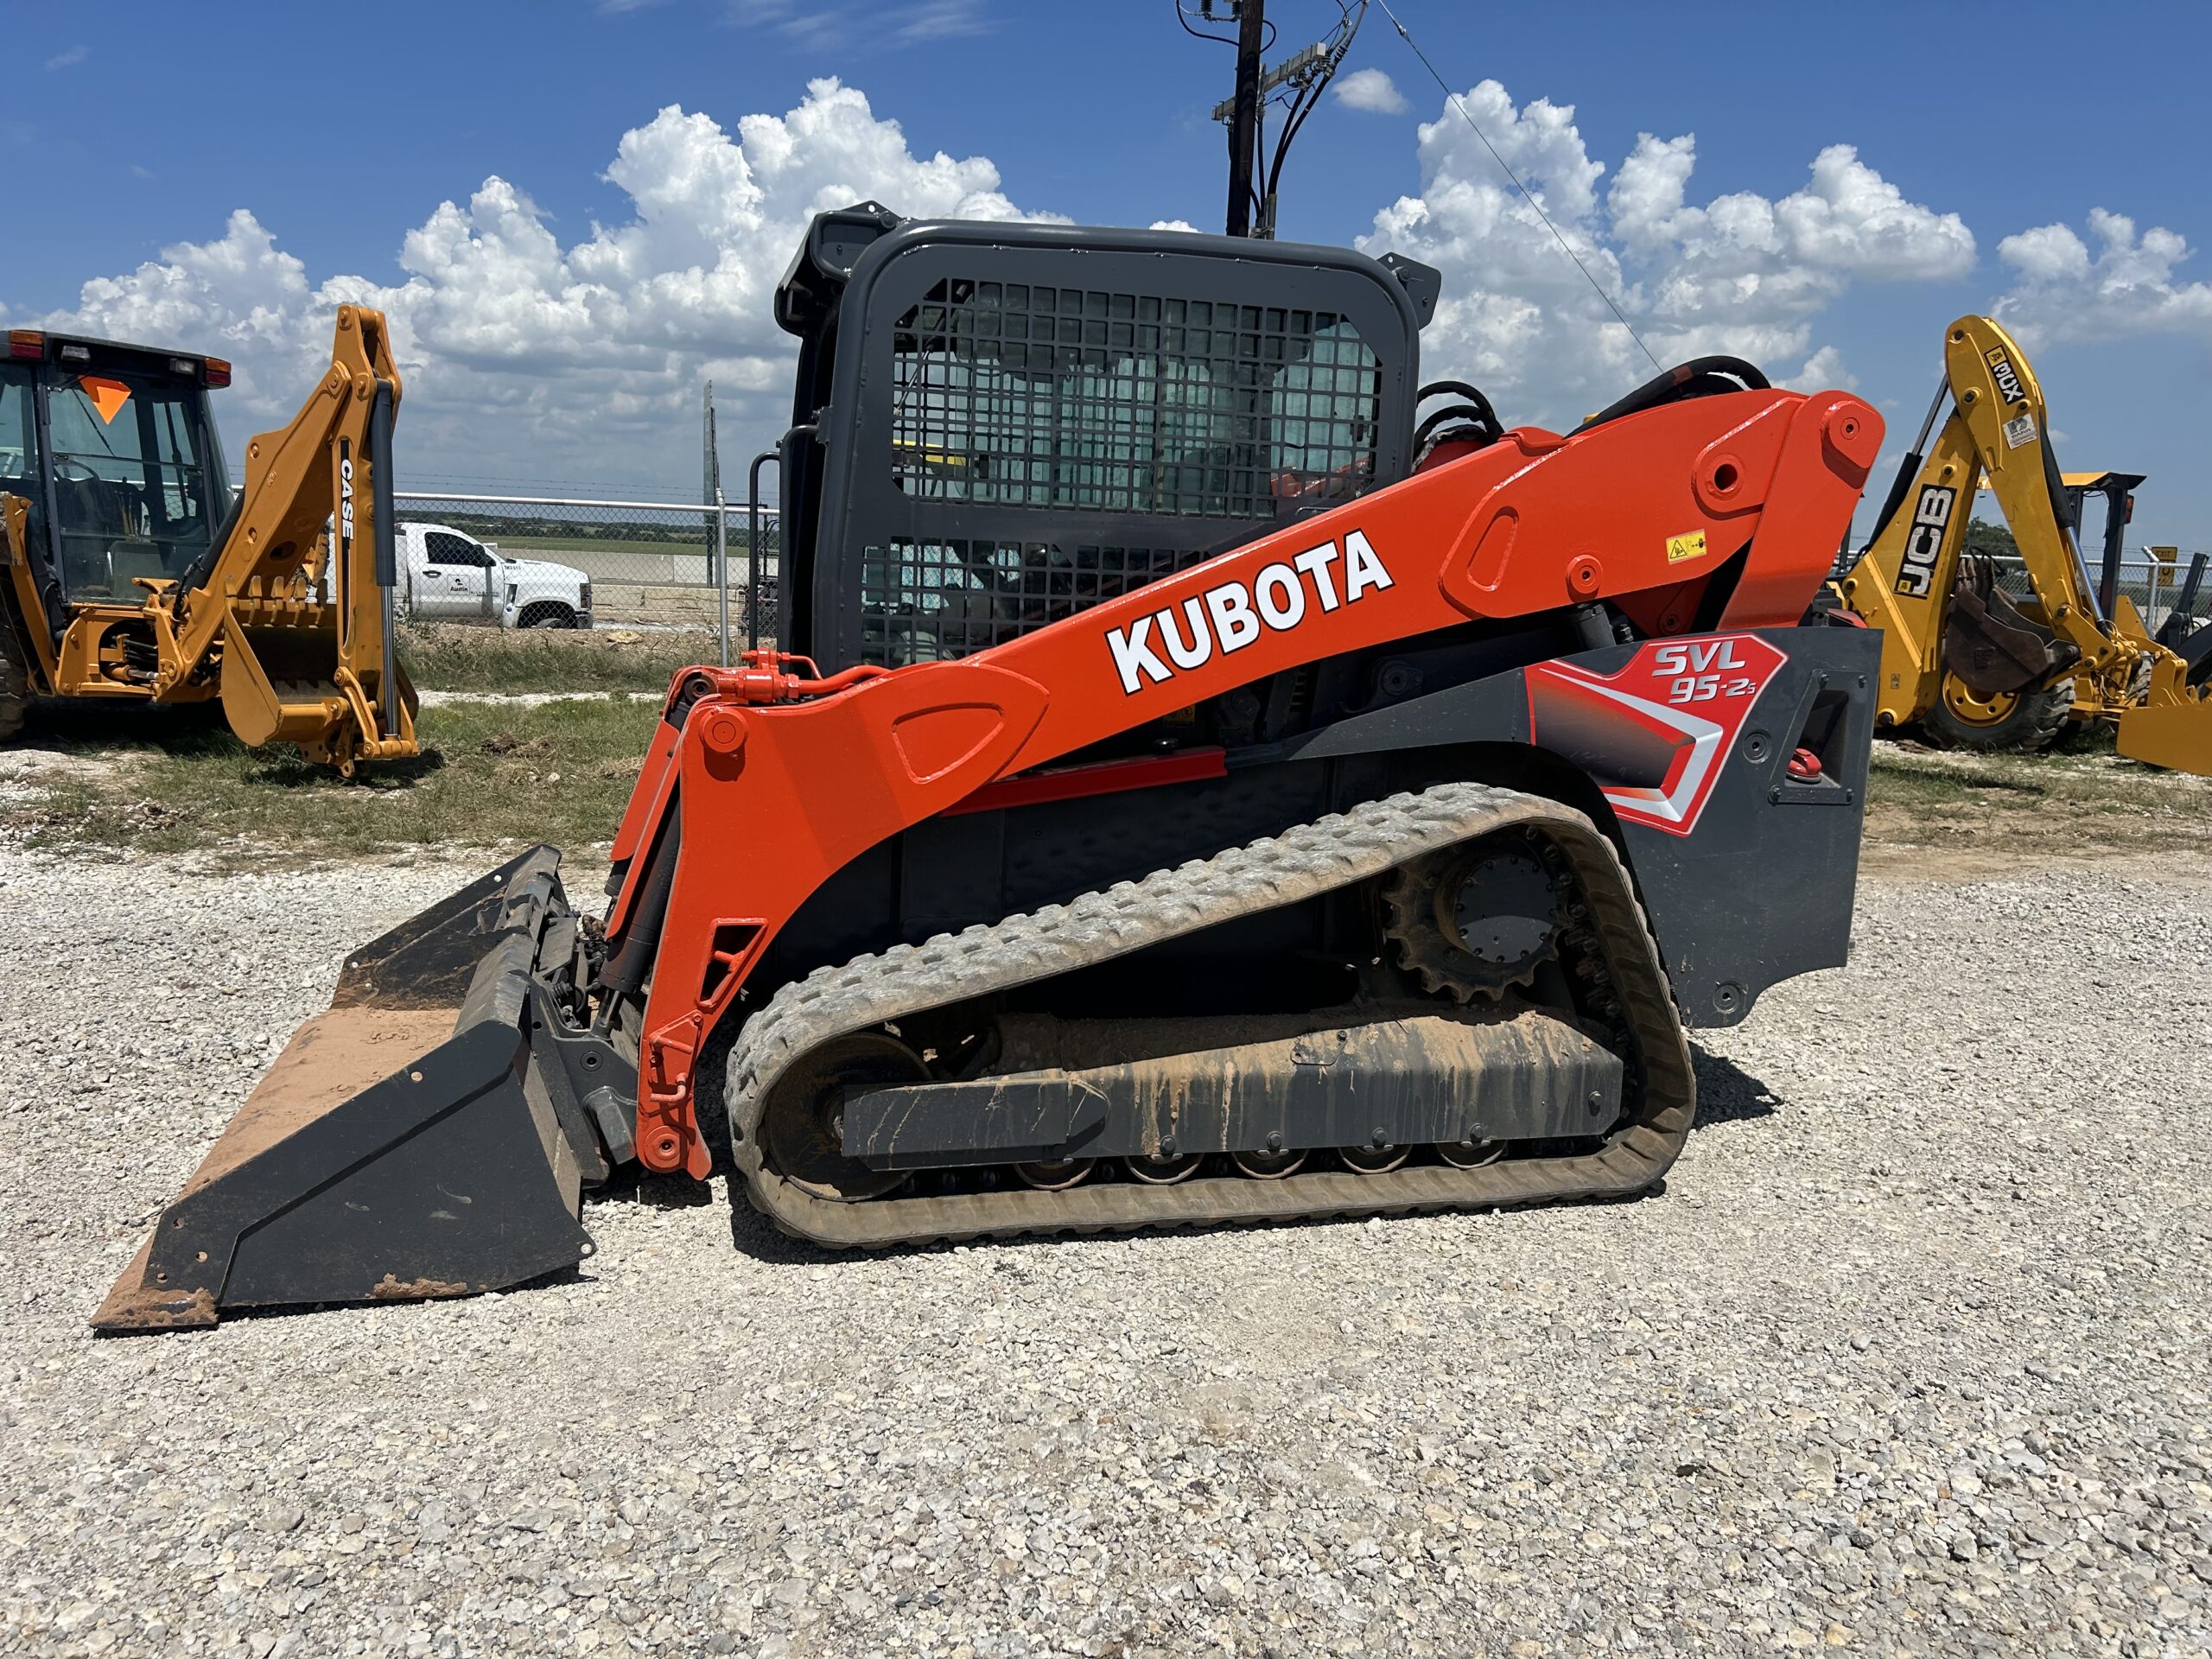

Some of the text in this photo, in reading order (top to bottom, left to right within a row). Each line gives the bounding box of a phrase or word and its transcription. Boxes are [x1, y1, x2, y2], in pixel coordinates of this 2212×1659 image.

[341, 459, 353, 540] CASE
[1902, 488, 1952, 594] JCB
[1106, 528, 1395, 696] KUBOTA
[1651, 640, 1745, 677] SVL
